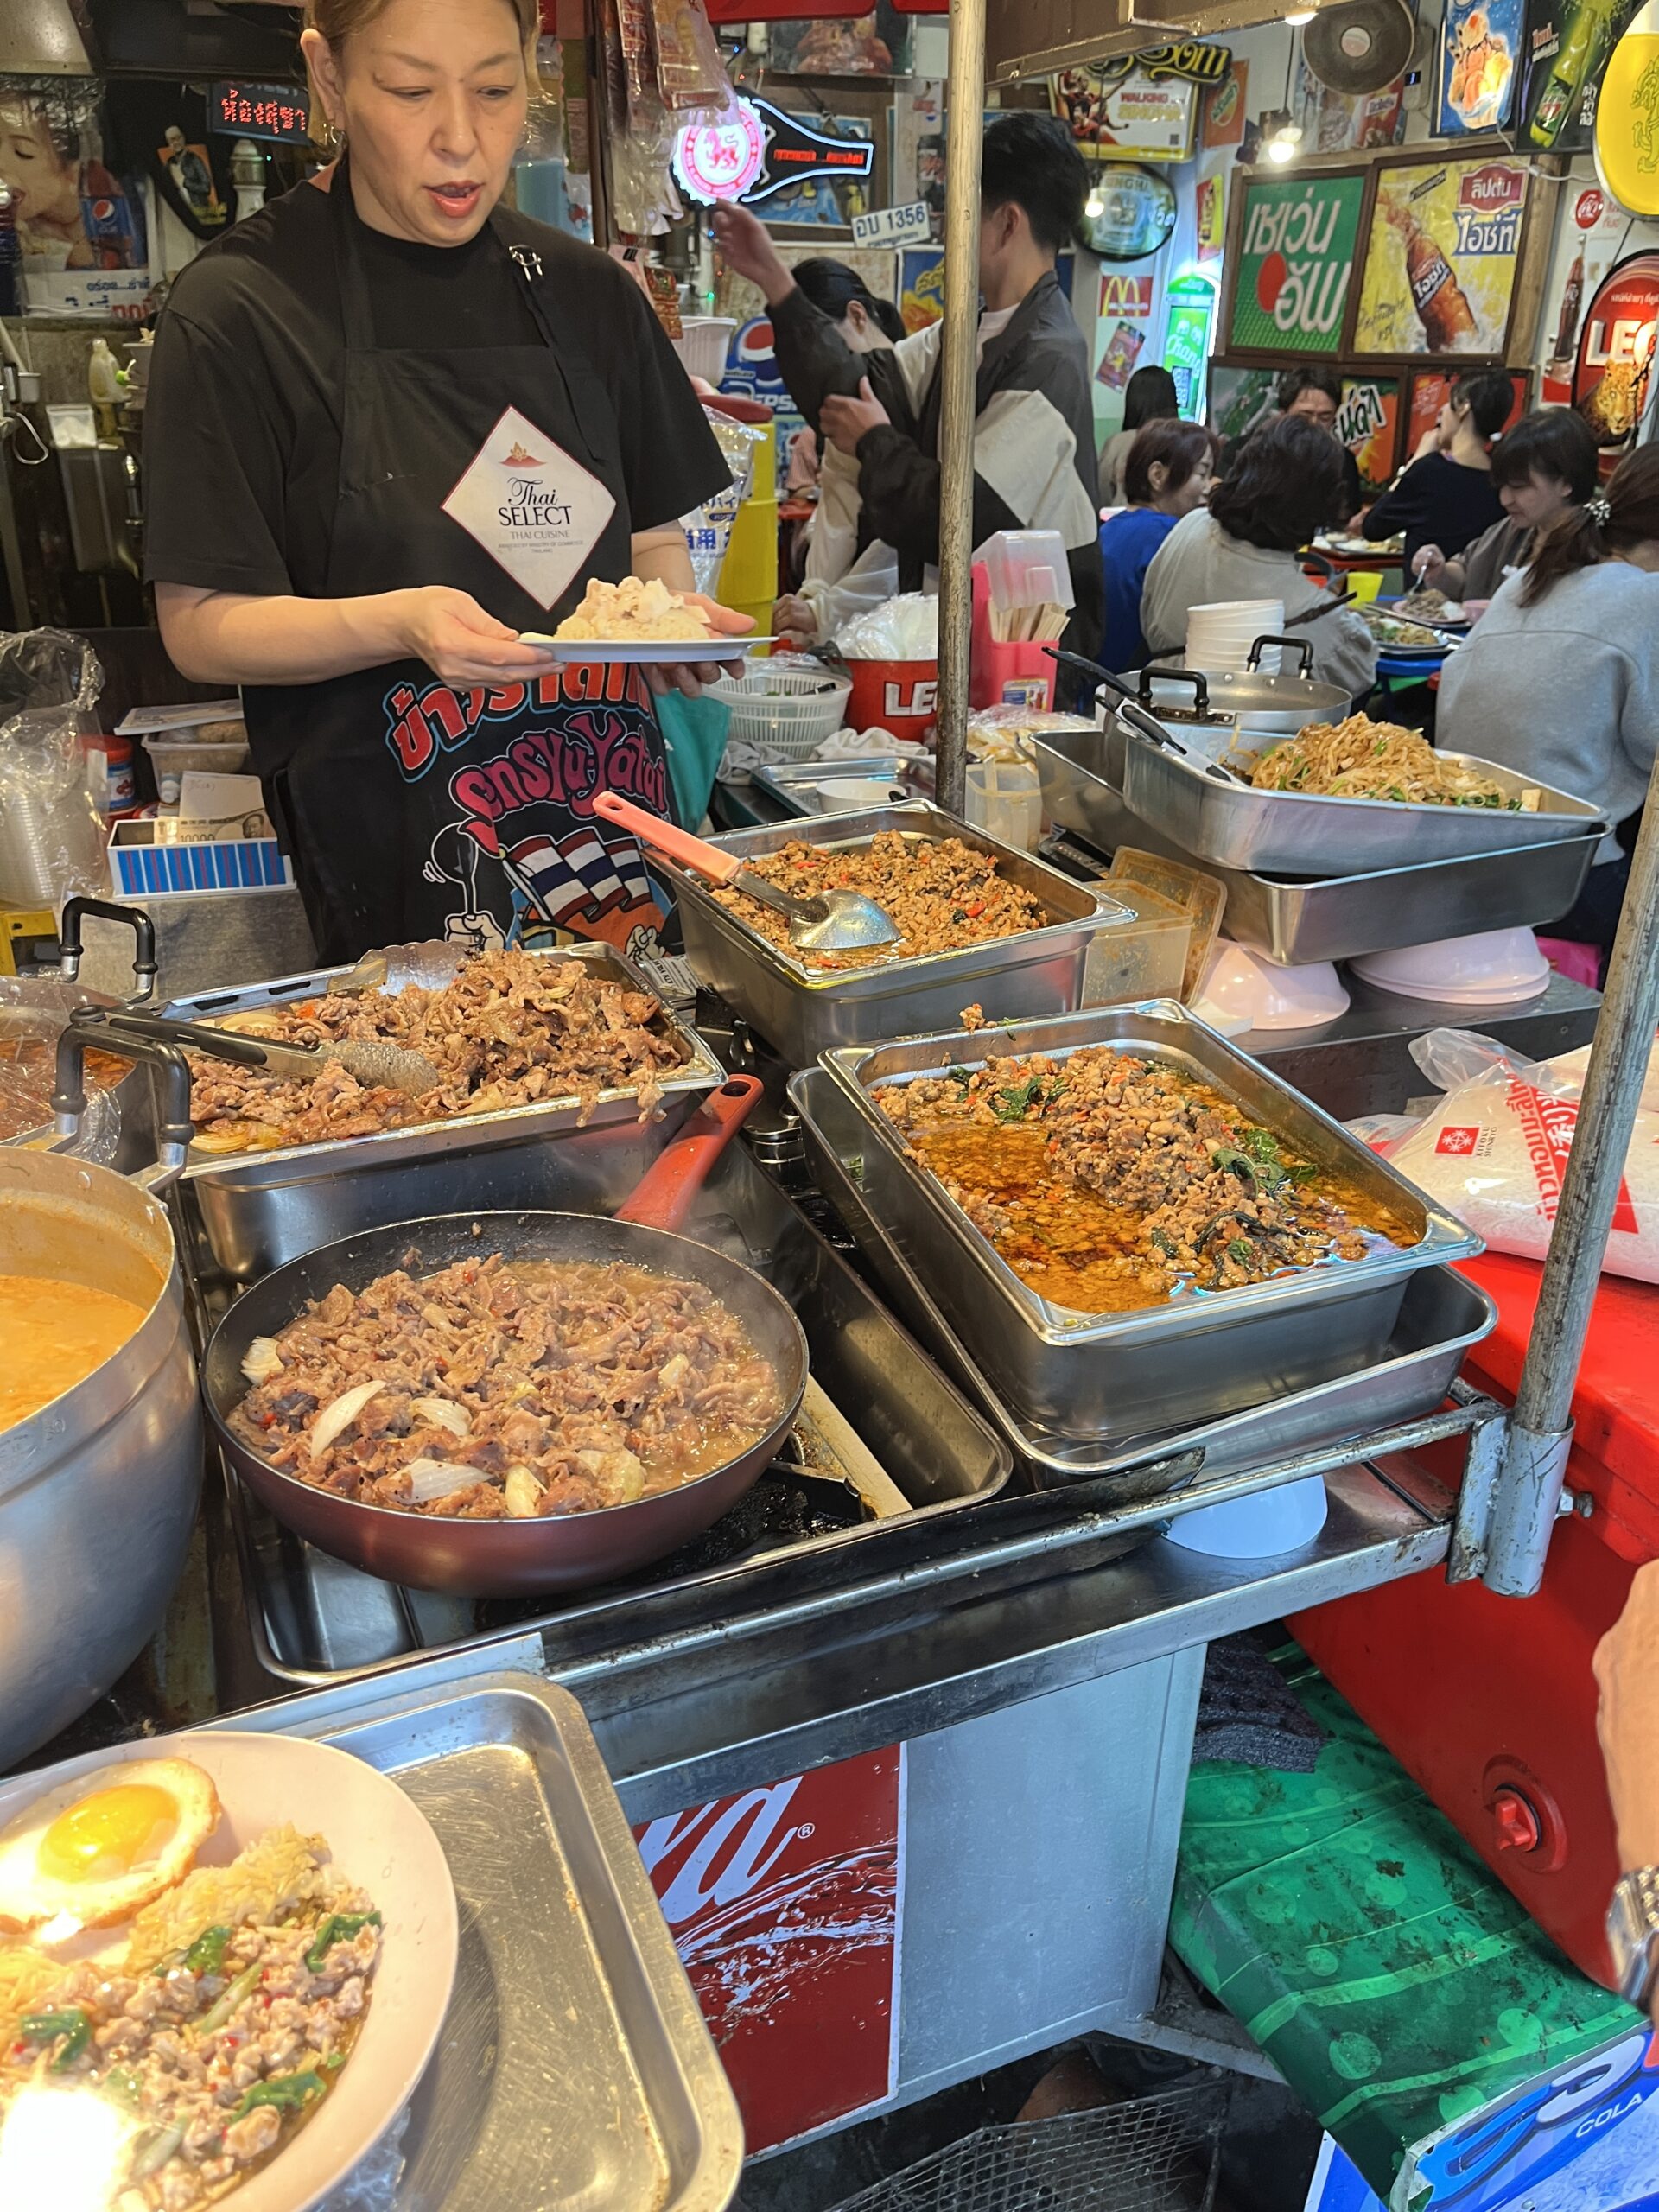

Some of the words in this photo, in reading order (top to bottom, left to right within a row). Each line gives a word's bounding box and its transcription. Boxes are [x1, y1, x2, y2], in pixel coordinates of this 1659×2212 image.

[887, 205, 925, 230] 1356
[1274, 262, 1352, 333] อัพ
[507, 477, 558, 506] Thai
[498, 505, 572, 526] SELECT
[511, 531, 532, 540] THAI
[533, 529, 570, 539] CUISINE
[885, 680, 938, 717] LE
[1484, 1126, 1497, 1158] SHINRYO
[1575, 2092, 1643, 2139] COLA
